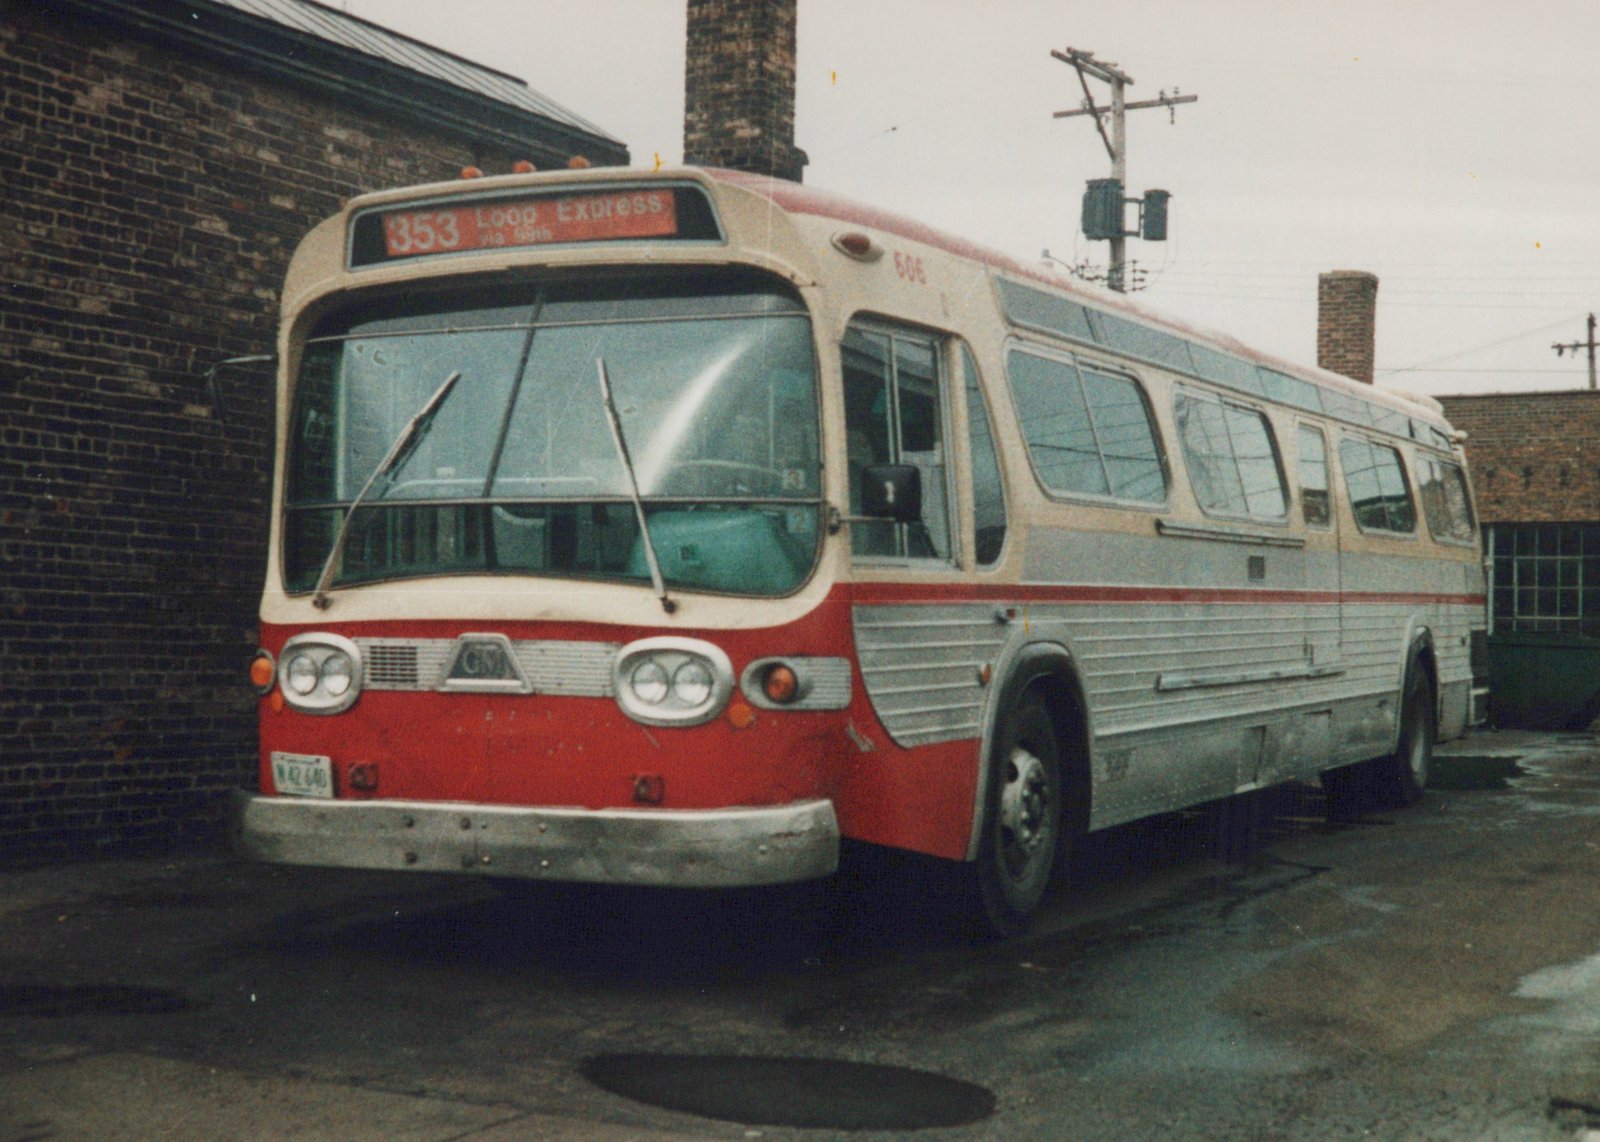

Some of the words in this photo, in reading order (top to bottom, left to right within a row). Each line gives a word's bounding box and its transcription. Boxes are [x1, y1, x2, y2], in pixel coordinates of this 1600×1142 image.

[388, 211, 460, 252] 353
[475, 206, 538, 229] Loop
[556, 194, 663, 222] Express
[893, 250, 927, 285] 606
